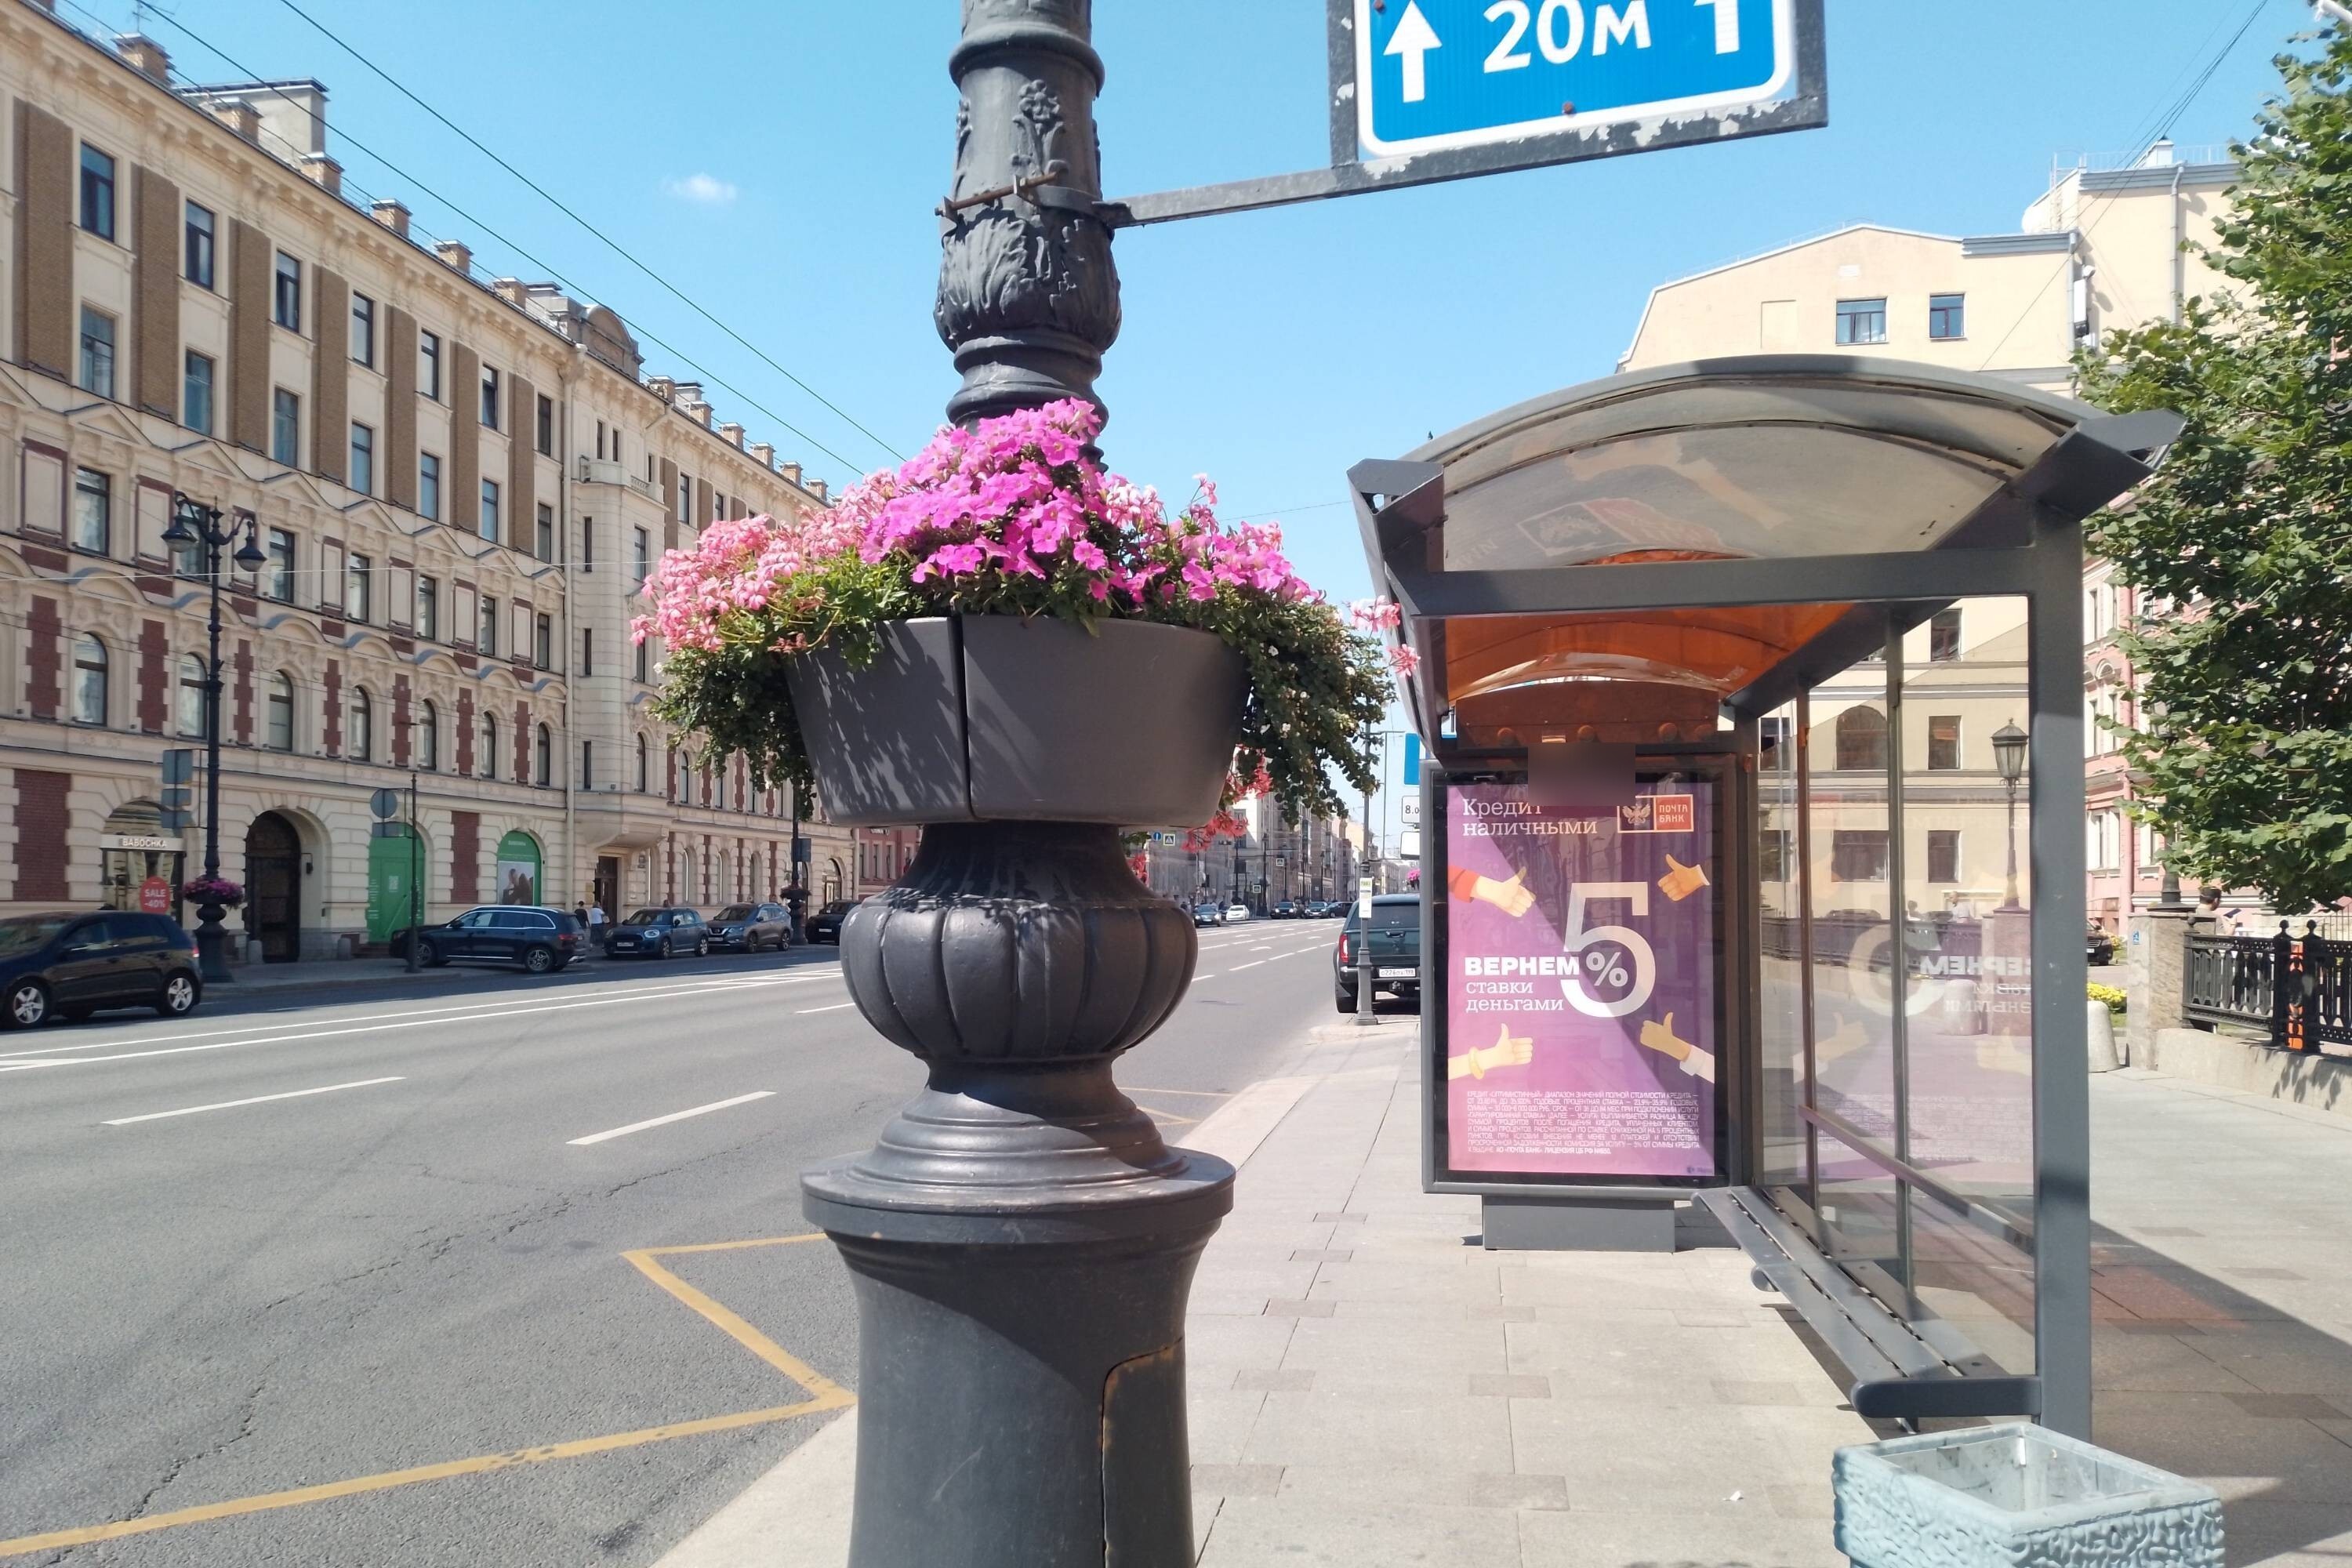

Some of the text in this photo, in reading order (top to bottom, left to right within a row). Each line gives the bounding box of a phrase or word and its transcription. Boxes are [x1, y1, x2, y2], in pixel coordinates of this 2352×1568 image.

[1483, 0, 1651, 74] 20м
[1659, 804, 1688, 813] ПОЧТА
[1463, 821, 1597, 837] наличными
[122, 837, 167, 848] BABOCHKA
[144, 888, 166, 898] SALE
[1465, 956, 1580, 976] ВЕРНЕМ
[1465, 982, 1534, 994] ставки
[1466, 999, 1564, 1013] деньгами
